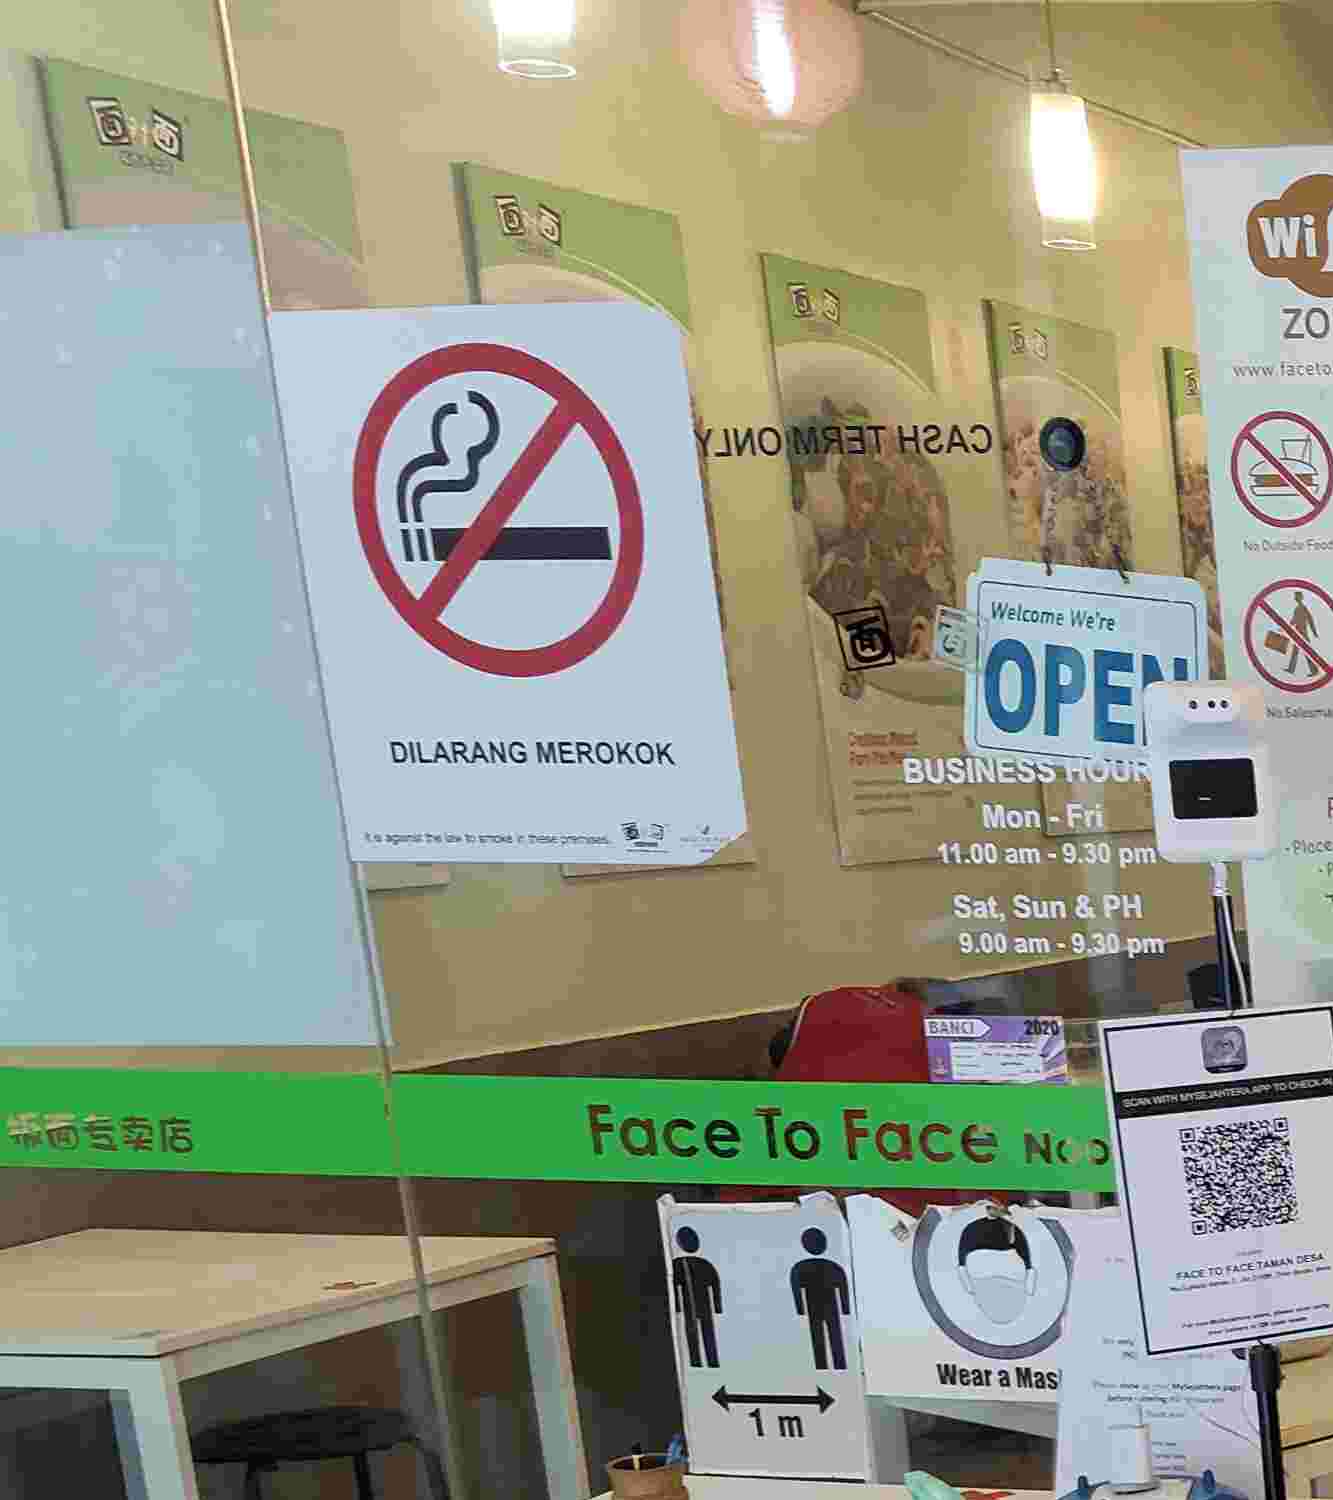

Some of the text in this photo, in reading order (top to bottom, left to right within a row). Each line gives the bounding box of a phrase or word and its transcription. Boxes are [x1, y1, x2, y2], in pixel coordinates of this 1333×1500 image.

[1243, 539, 1259, 551] No
[991, 601, 1117, 632] Welcome We're
[1266, 705, 1282, 719] No
[389, 741, 677, 766] DILARANG MEROKOK
[903, 757, 1056, 785] BUSINESS
[1065, 758, 1153, 785] HOUR
[982, 802, 1041, 829] Mon
[1065, 802, 1105, 829] Fri
[937, 842, 998, 865] 11.00
[1004, 847, 1041, 865] am
[1061, 842, 1111, 865] 9.30
[1119, 847, 1158, 868] pm
[952, 893, 1144, 922] Sat, Sun & PH
[958, 931, 1008, 954] 9.00
[1013, 936, 1050, 954] am
[1070, 931, 1121, 954] 9.30
[1126, 936, 1166, 959] pm
[928, 1019, 1060, 1036] BANCI 2020
[1121, 1097, 1150, 1109] SCAN
[1151, 1094, 1178, 1105] WITH
[1273, 1081, 1288, 1092] TO
[586, 1103, 1110, 1167] Face To Face Noo
[1175, 1270, 1204, 1281] FACE
[1207, 1266, 1224, 1276] TO
[1225, 1261, 1254, 1273] FACE
[1255, 1256, 1294, 1270] TAMAN
[1296, 1252, 1325, 1265] DESA
[936, 1362, 993, 1389] Wear
[996, 1369, 1011, 1389] a
[1014, 1363, 1063, 1392] Mas
[747, 1410, 806, 1439] 1 m
